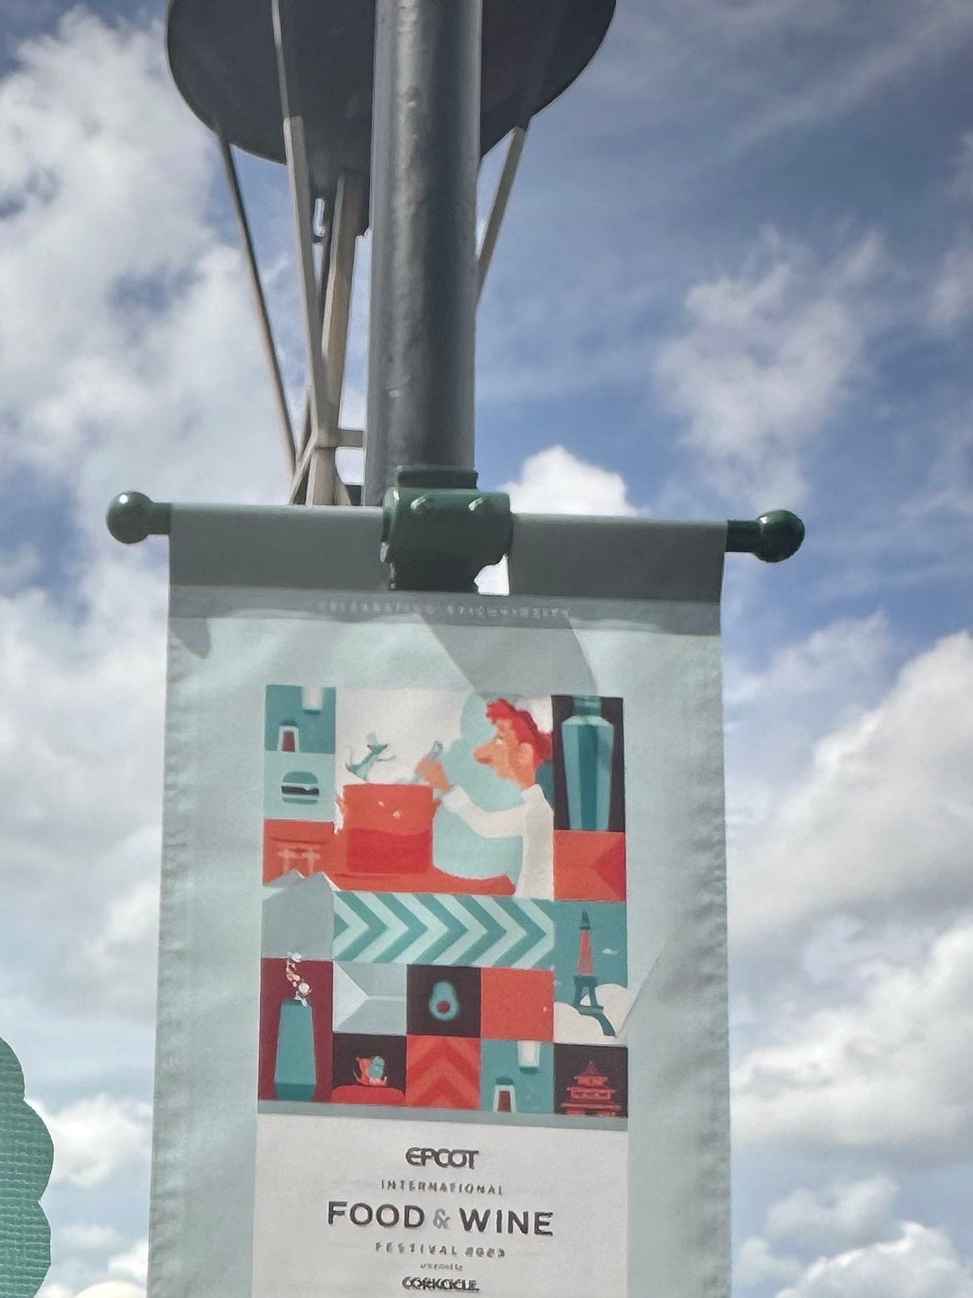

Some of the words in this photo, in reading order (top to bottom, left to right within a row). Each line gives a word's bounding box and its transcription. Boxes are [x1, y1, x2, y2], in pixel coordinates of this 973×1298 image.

[405, 1146, 480, 1170] EPCOT
[380, 1179, 504, 1196] INTERNATIONAL
[327, 1200, 426, 1229] FOOD
[432, 1207, 451, 1230] &
[458, 1207, 554, 1237] WINE
[375, 1241, 458, 1257] FESTIVAL
